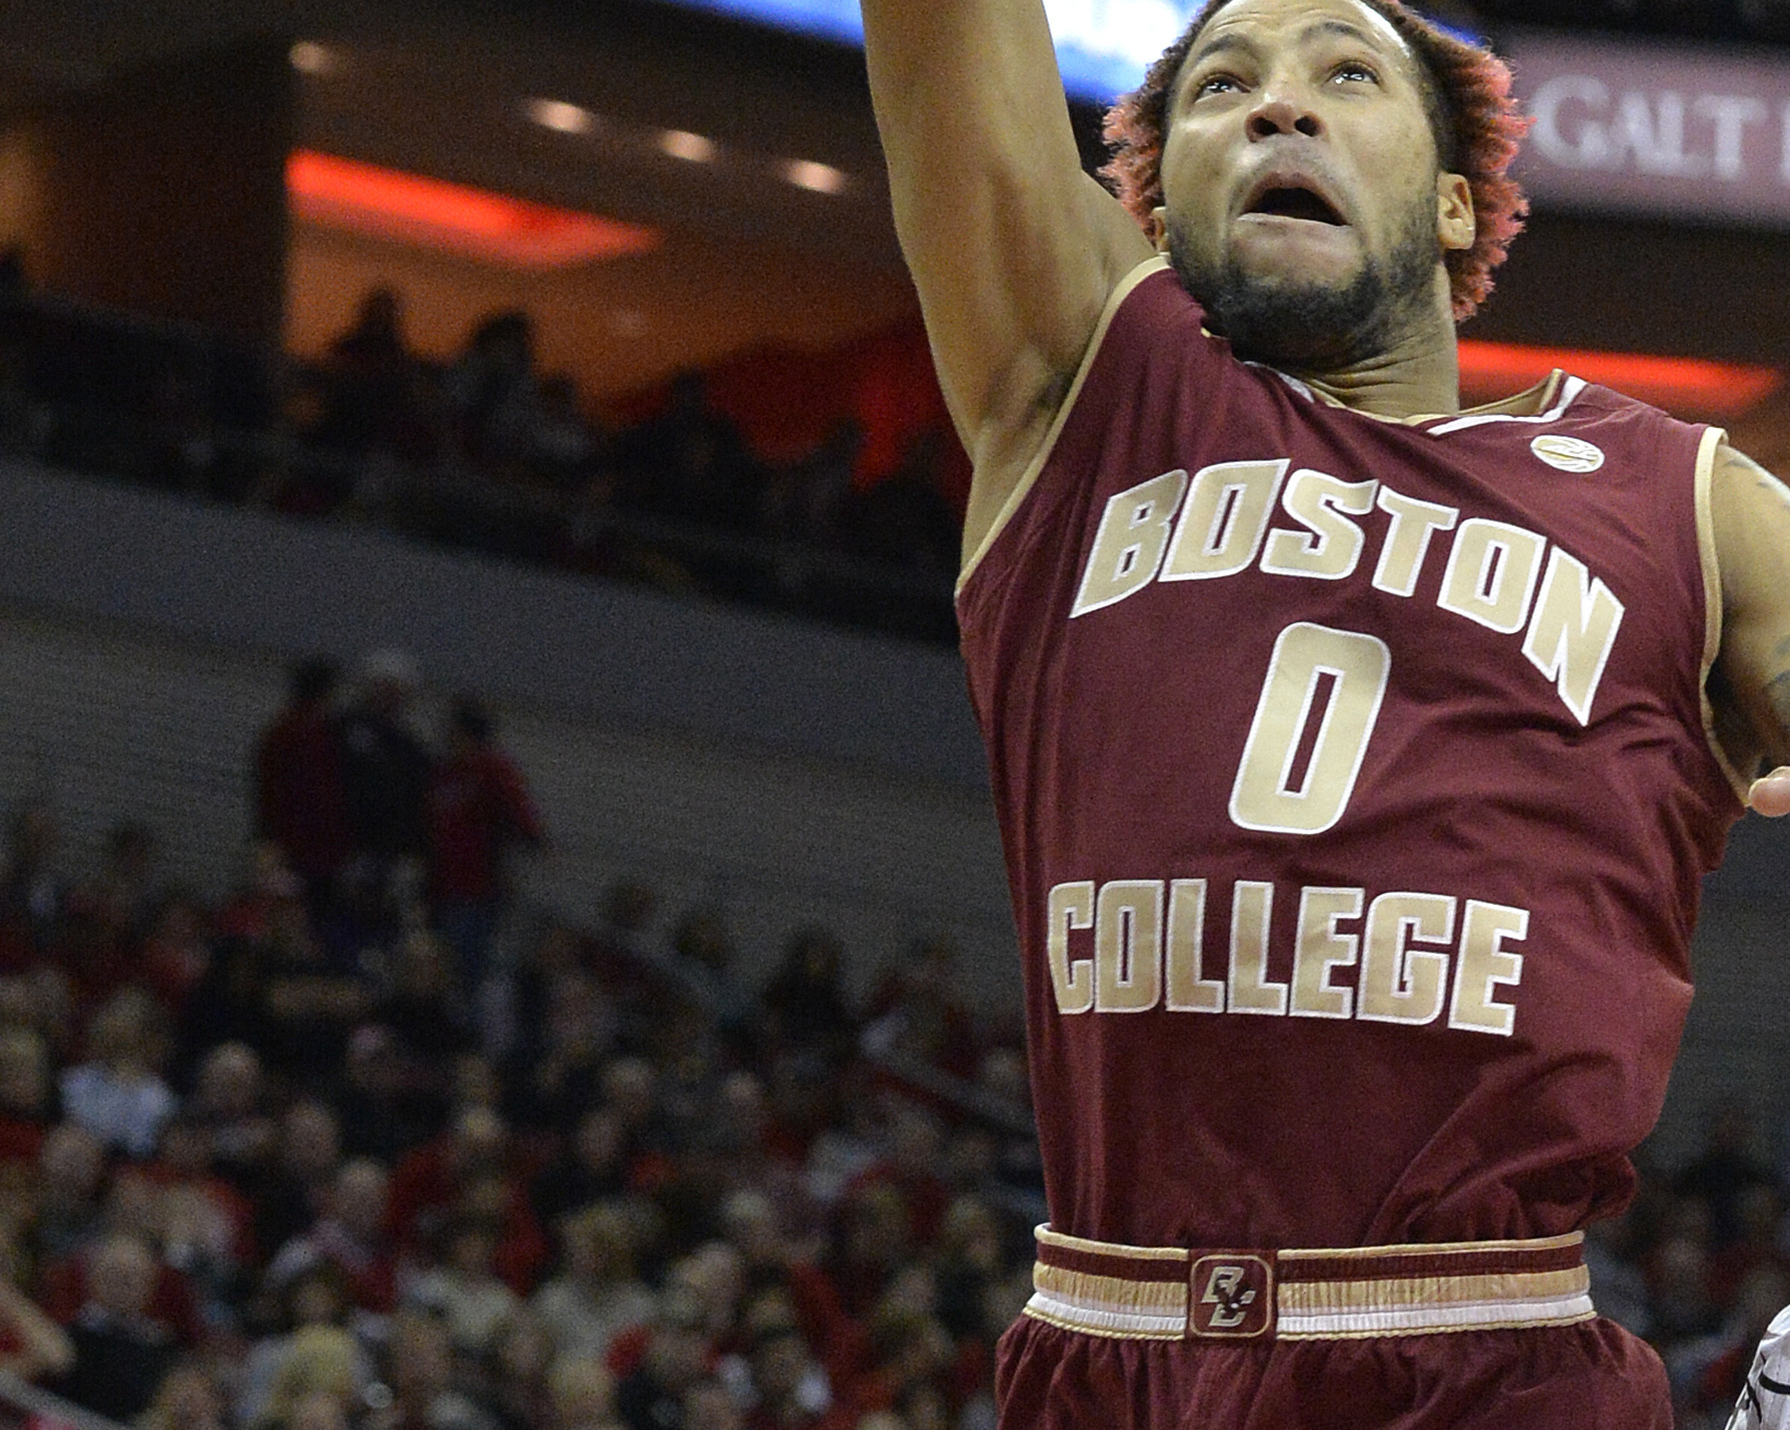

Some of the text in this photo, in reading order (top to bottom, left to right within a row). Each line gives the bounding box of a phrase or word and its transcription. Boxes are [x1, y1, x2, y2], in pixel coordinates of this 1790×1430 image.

[1528, 75, 1770, 182] GALT
[1069, 457, 1626, 727] BOSTON
[1227, 621, 1391, 835] 0
[1047, 877, 1531, 1037] COLLEGE
